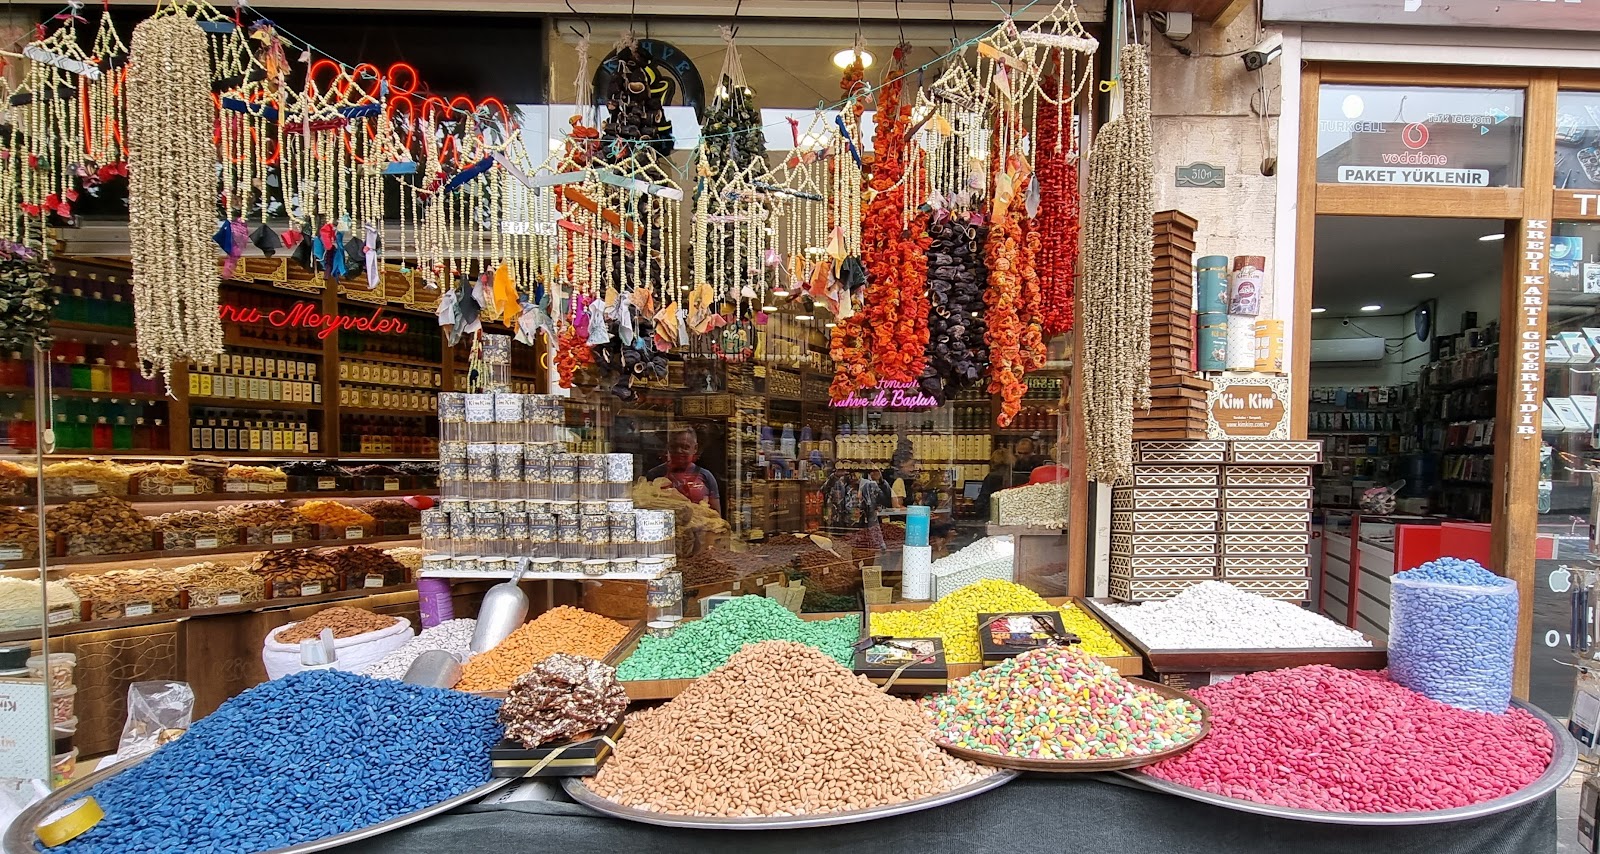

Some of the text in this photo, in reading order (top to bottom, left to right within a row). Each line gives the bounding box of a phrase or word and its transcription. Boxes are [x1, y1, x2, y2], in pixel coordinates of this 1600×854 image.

[1382, 151, 1448, 165] vodafone
[1345, 168, 1482, 184] PAKET YÜKLENİR
[1525, 219, 1547, 271] KREDİ
[1523, 275, 1544, 326] KARTI
[268, 302, 407, 340] Meyveler
[872, 389, 888, 407] ile
[1220, 393, 1244, 409] Kim
